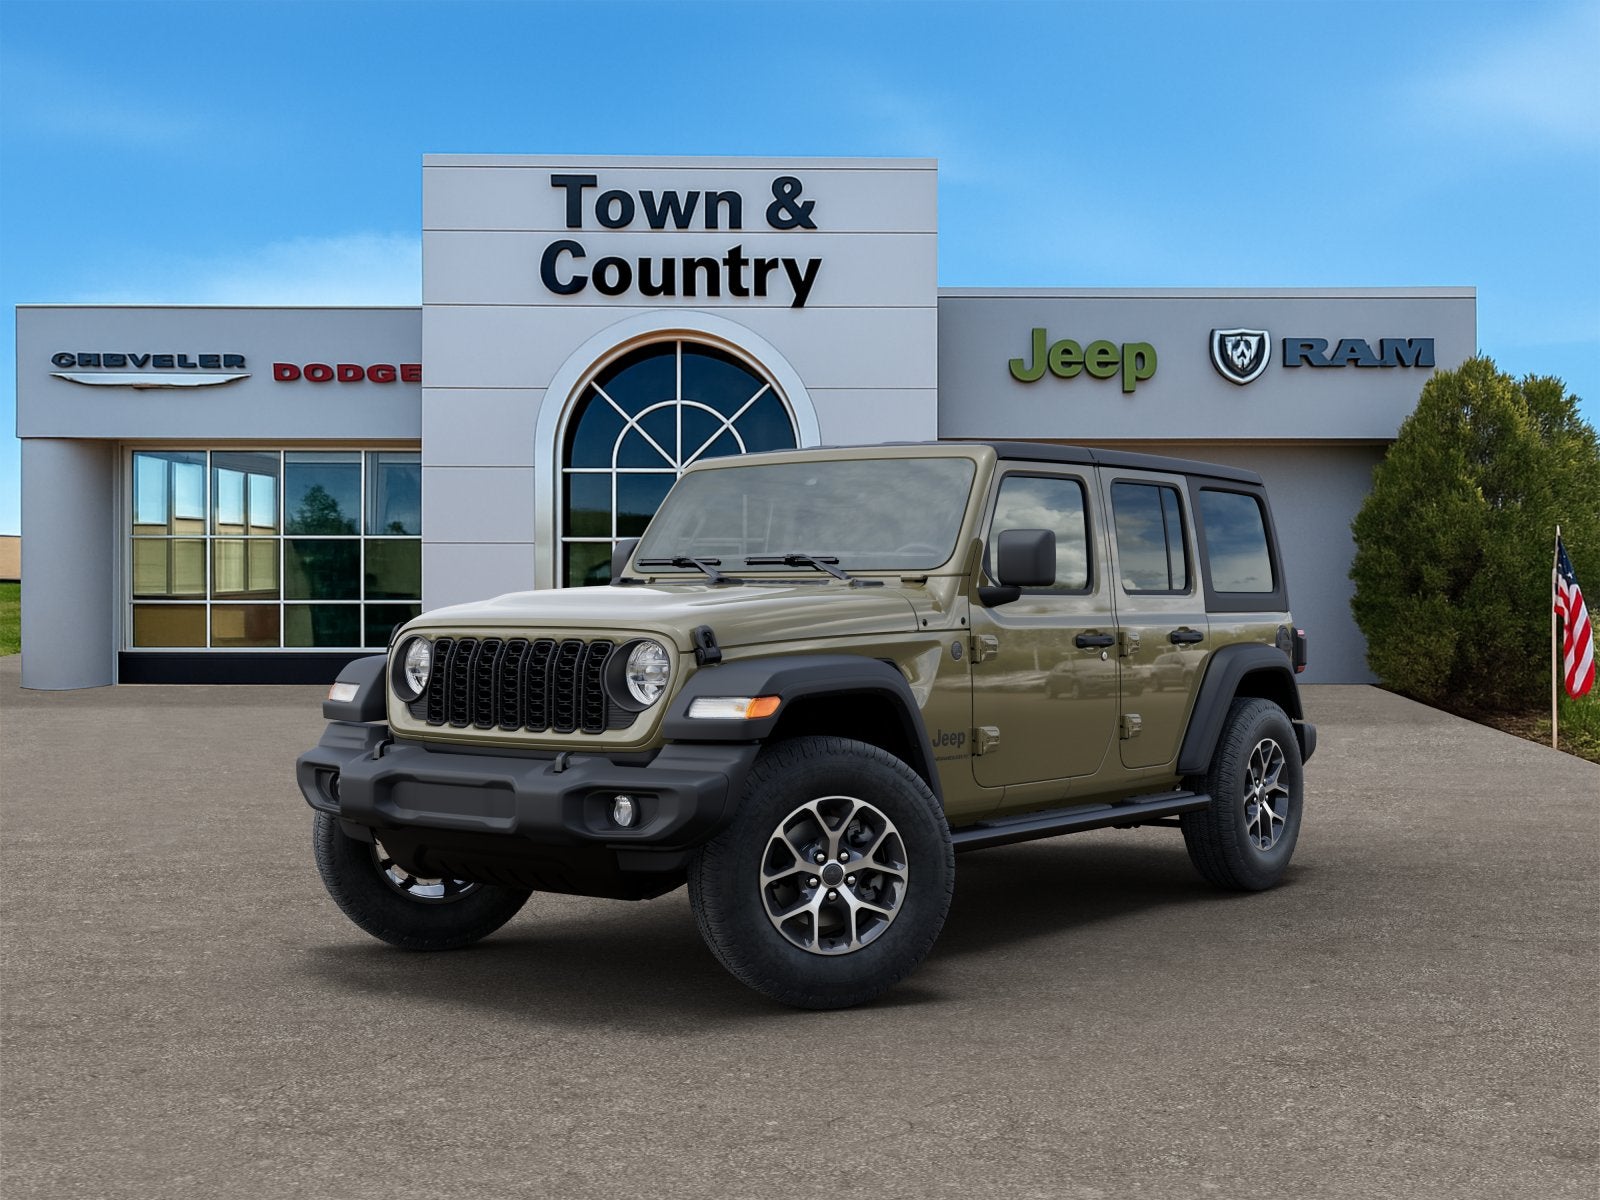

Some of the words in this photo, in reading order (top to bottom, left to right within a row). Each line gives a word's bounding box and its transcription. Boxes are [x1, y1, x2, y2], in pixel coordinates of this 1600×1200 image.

[550, 174, 743, 230] Town
[765, 175, 818, 230] &
[540, 239, 823, 308] Country
[272, 363, 422, 383] DODGE
[1008, 328, 1158, 393] Jeep
[1282, 337, 1435, 368] RAM
[932, 729, 966, 748] Jeep
